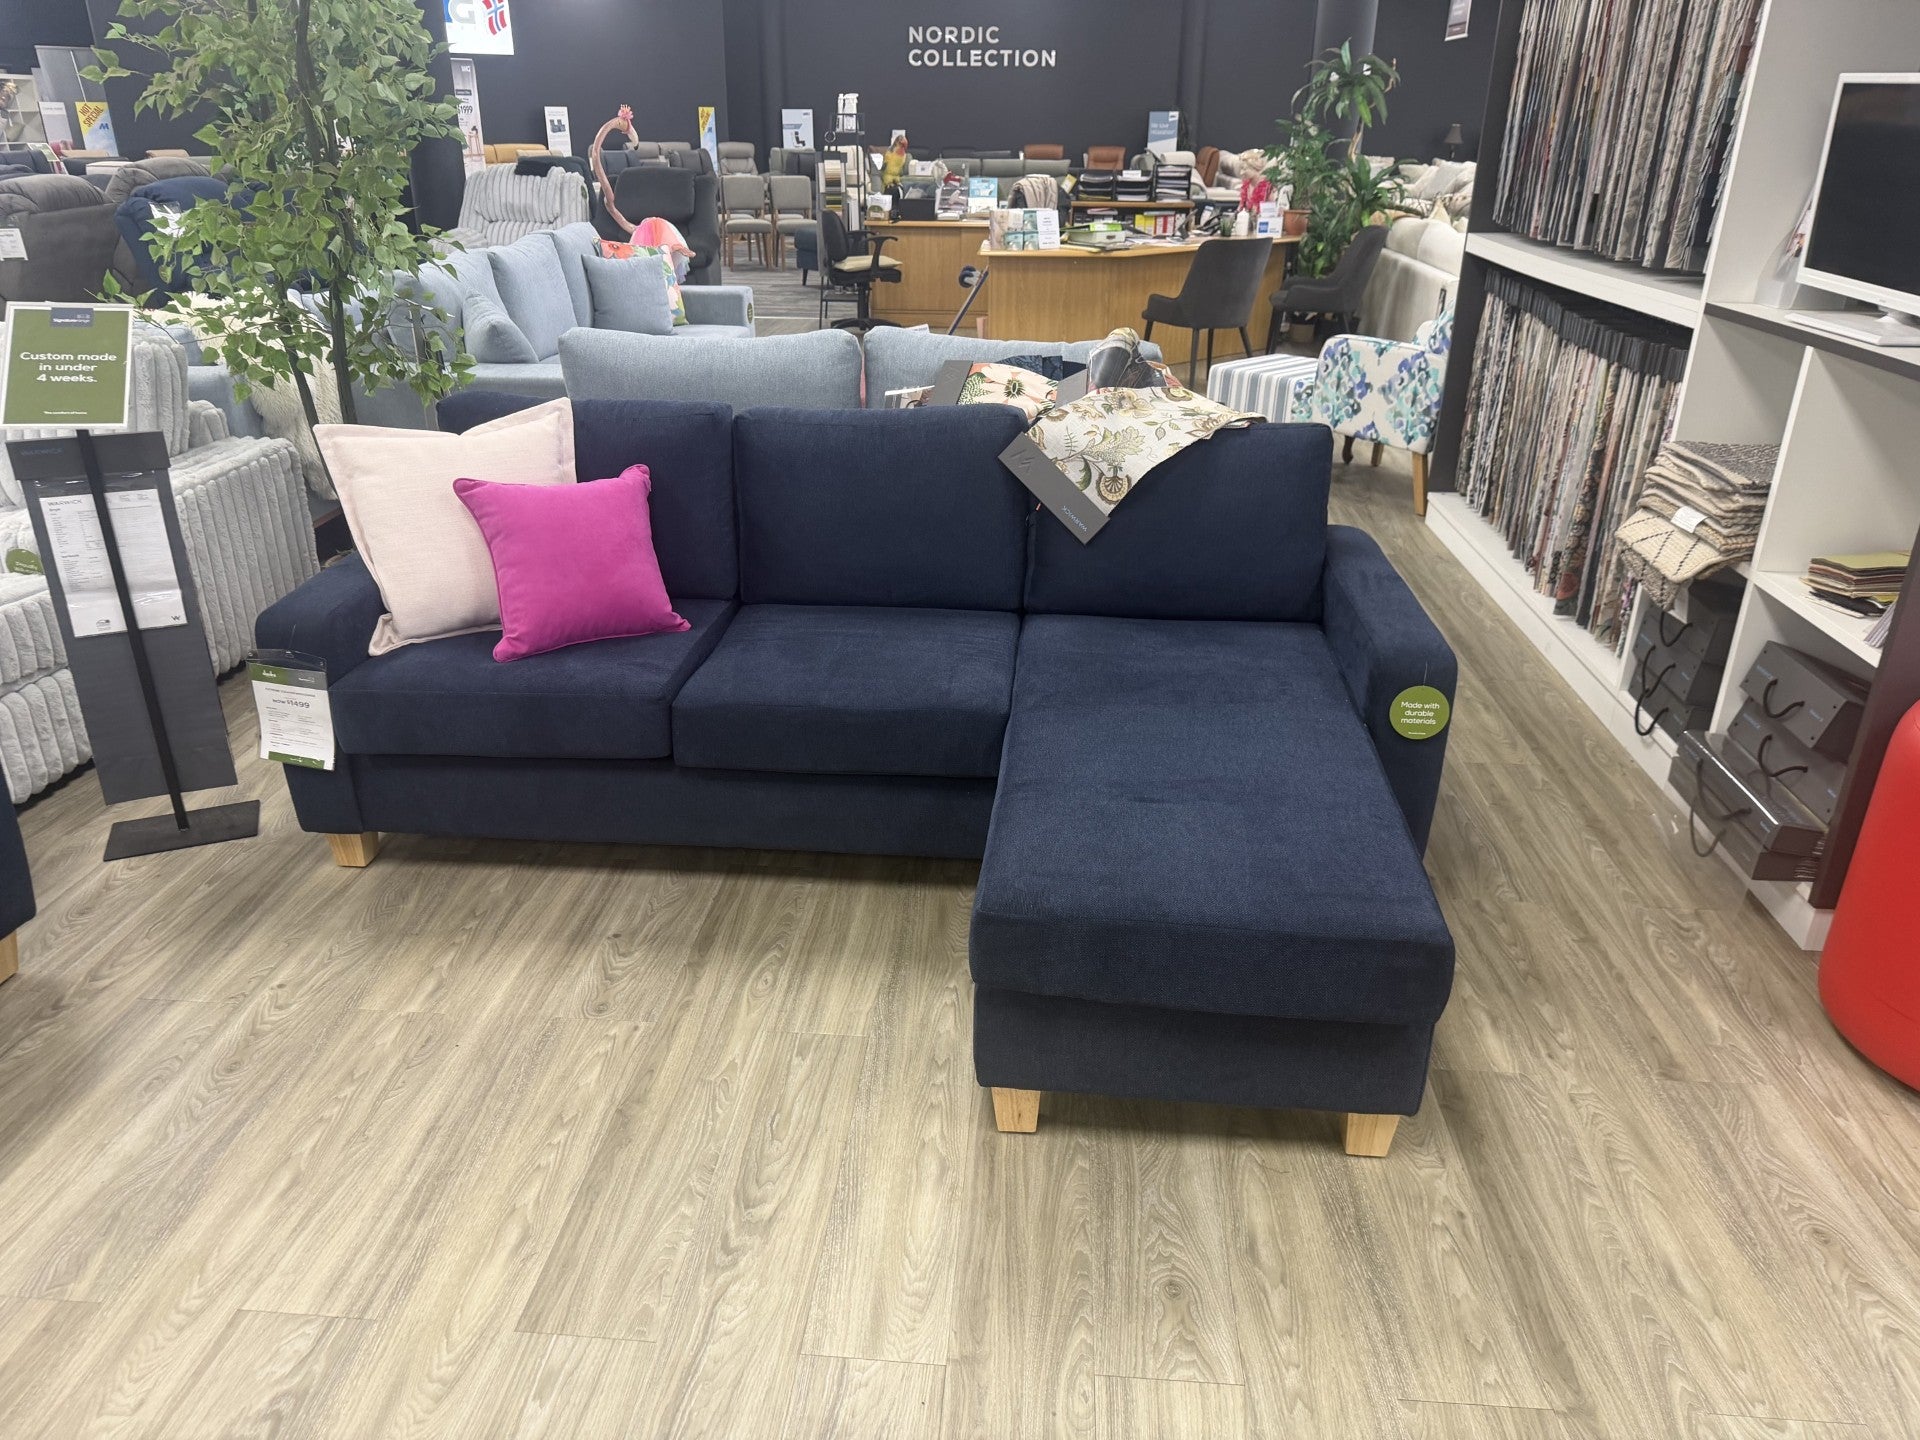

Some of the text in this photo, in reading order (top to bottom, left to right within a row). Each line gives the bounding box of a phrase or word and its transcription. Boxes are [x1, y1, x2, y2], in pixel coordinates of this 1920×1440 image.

[908, 26, 1000, 44] NORDIC
[908, 49, 1057, 67] COLLECTION
[20, 351, 117, 361] Custom made
[39, 362, 98, 372] in under
[36, 373, 98, 383] 4 weeks.
[1400, 701, 1440, 710] Made with
